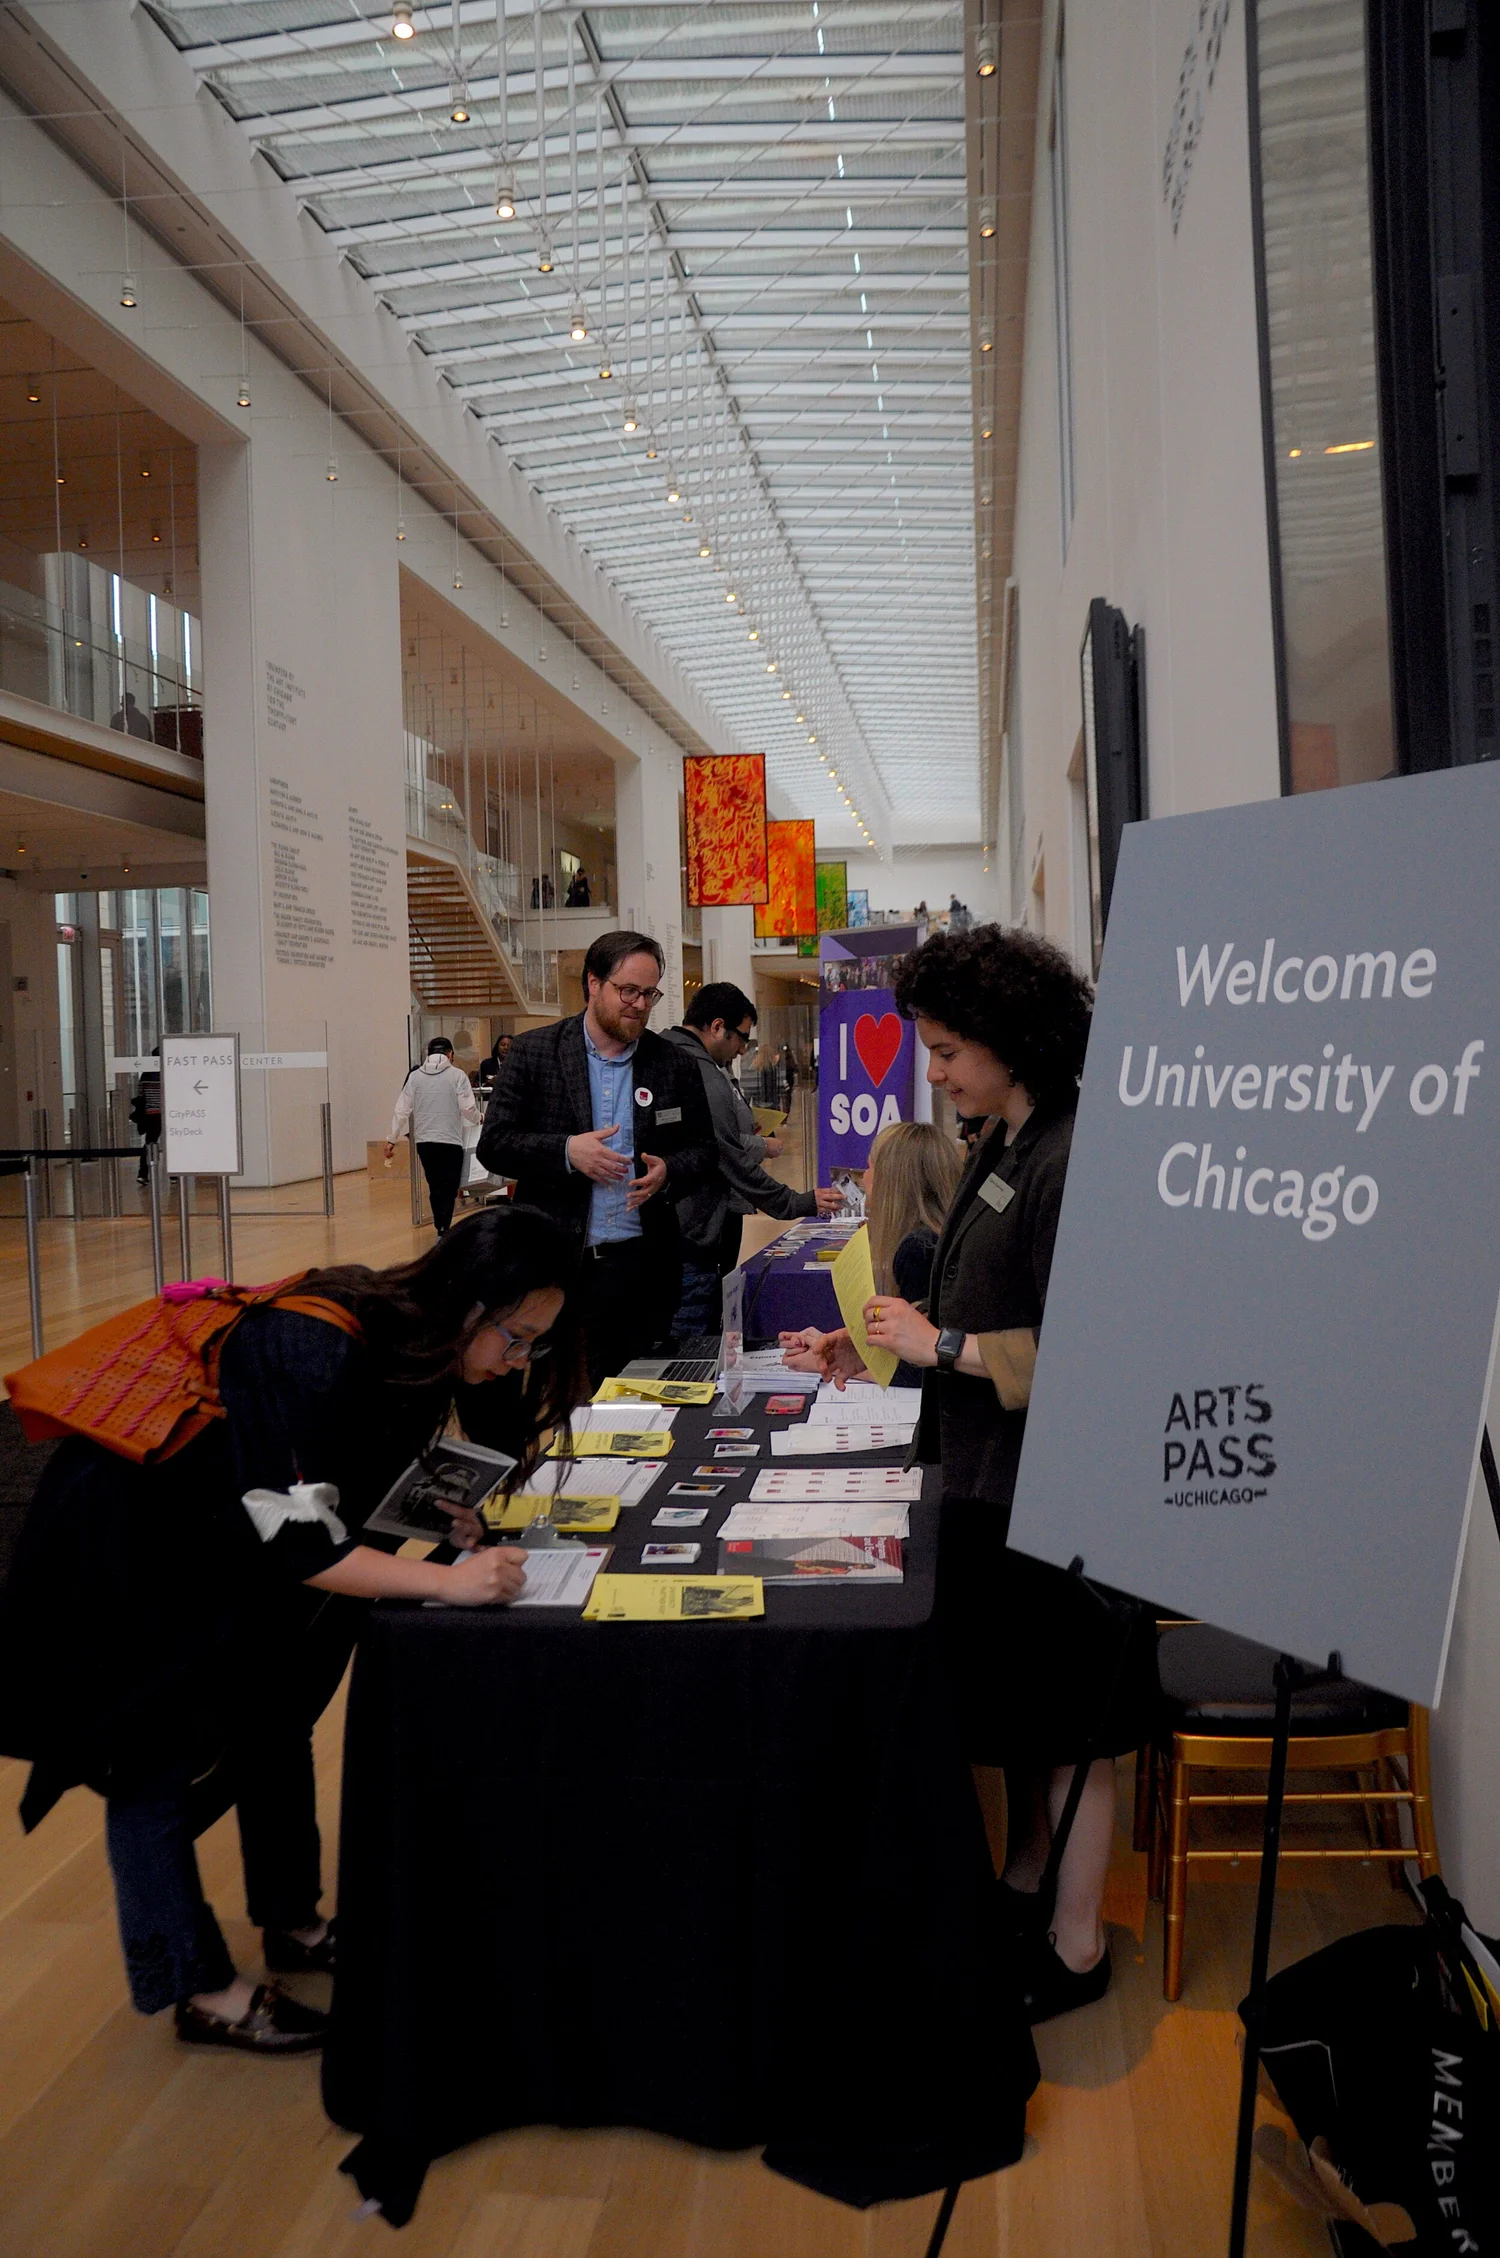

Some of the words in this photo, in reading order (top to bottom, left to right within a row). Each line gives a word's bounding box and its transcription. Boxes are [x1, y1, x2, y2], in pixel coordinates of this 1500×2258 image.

[1176, 938, 1437, 1007] Welcome
[167, 1056, 198, 1066] FAST
[203, 1055, 234, 1065] PASS
[242, 1057, 283, 1066] CENTER
[840, 1023, 848, 1081] I
[1118, 1043, 1395, 1132] University
[1409, 1039, 1485, 1116] of
[169, 1109, 206, 1119] CityPASS
[169, 1127, 204, 1137] SkyDeck
[830, 1093, 903, 1136] SOA
[1157, 1141, 1379, 1241] Chicago
[1164, 1383, 1273, 1433] ARTS
[1164, 1433, 1278, 1483] PASS
